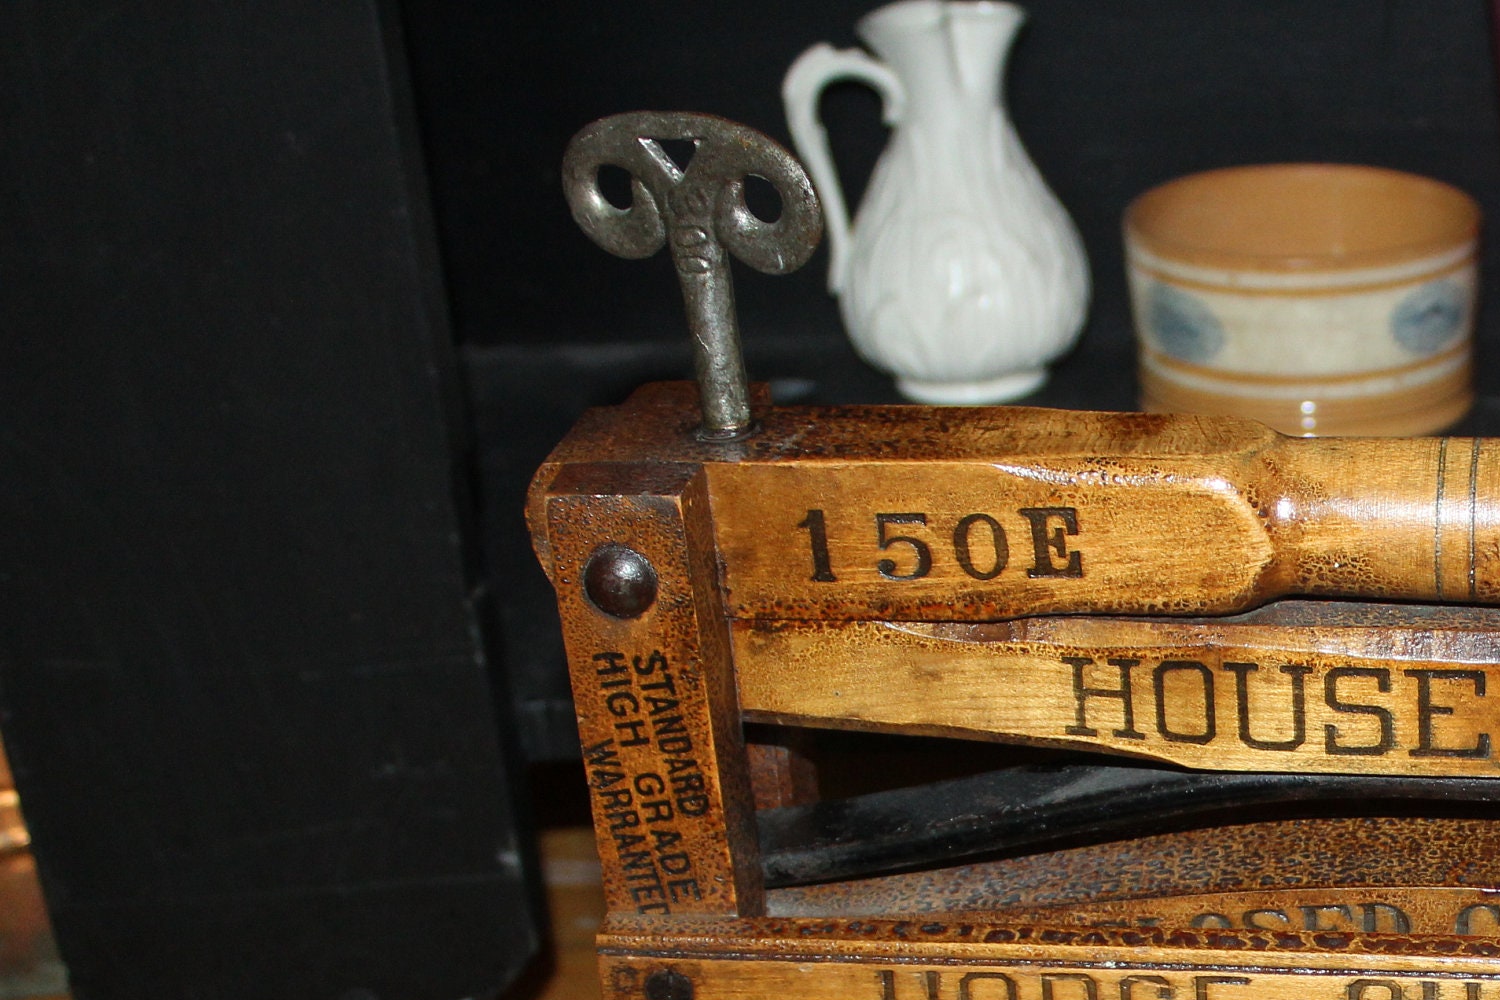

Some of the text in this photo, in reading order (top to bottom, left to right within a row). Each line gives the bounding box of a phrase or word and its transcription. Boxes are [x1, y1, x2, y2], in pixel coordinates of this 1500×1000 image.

[797, 506, 1084, 582] 150E
[593, 651, 701, 903] HIGH GRADE
[632, 650, 710, 817] STANDARD
